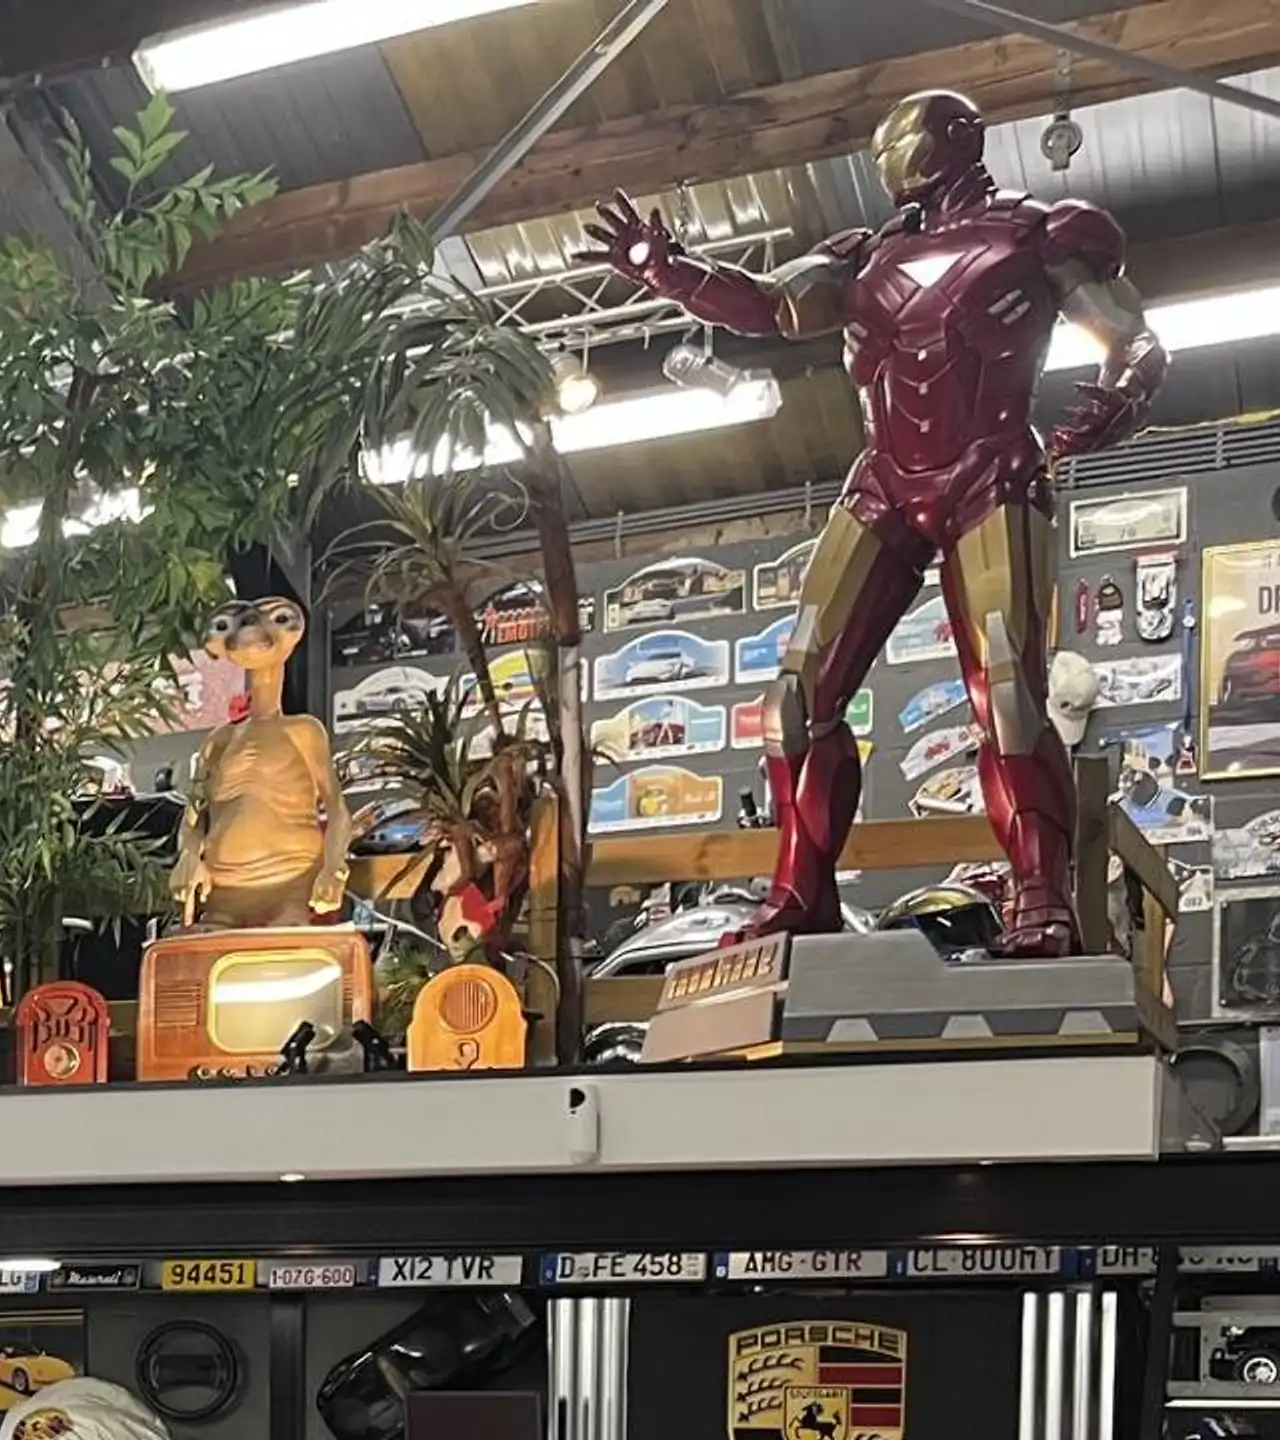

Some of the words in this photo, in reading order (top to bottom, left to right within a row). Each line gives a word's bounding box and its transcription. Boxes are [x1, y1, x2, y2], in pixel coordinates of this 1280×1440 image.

[170, 1263, 246, 1285] 94451
[443, 1256, 495, 1280] TVR
[632, 1253, 683, 1277] 458
[736, 1325, 900, 1356] PORSCHE
